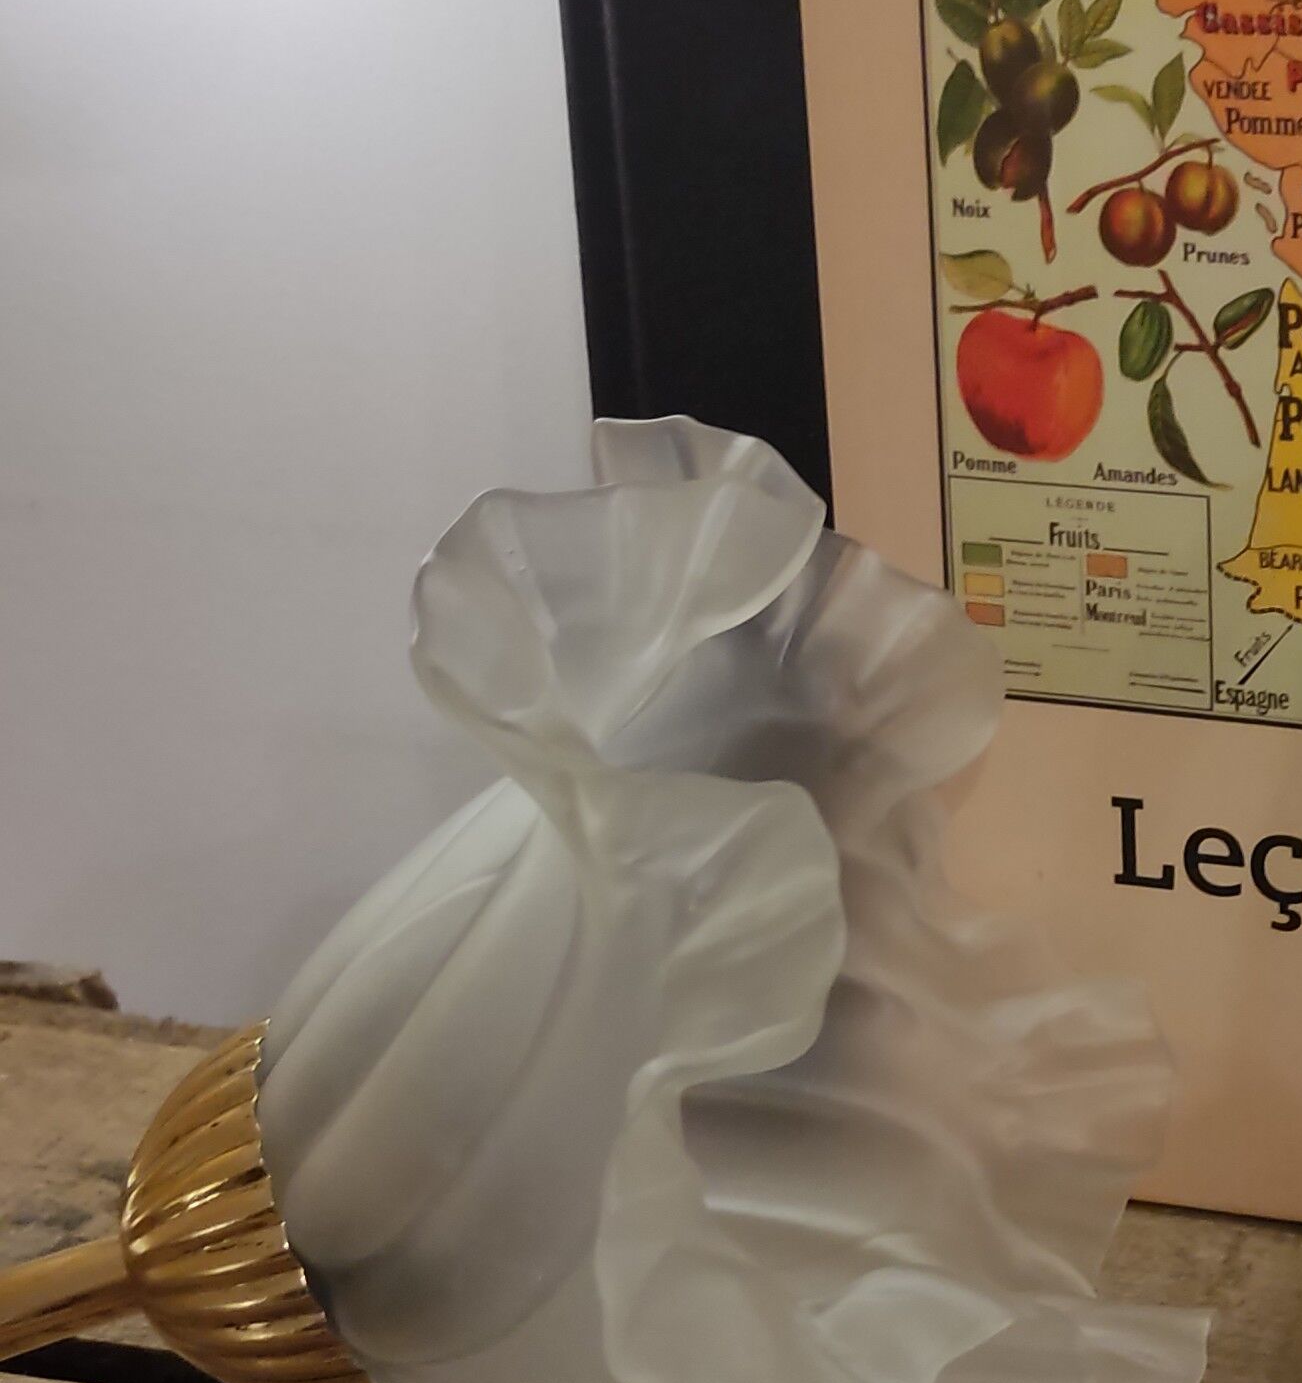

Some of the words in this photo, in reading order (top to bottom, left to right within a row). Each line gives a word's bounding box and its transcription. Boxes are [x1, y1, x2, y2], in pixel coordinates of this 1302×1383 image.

[951, 198, 991, 219] Noix
[1182, 242, 1250, 266] Prunes
[951, 451, 1018, 475] Pomme
[1093, 462, 1178, 487] Amandes
[1049, 521, 1101, 550] Fruits
[1214, 679, 1290, 717] Espagne
